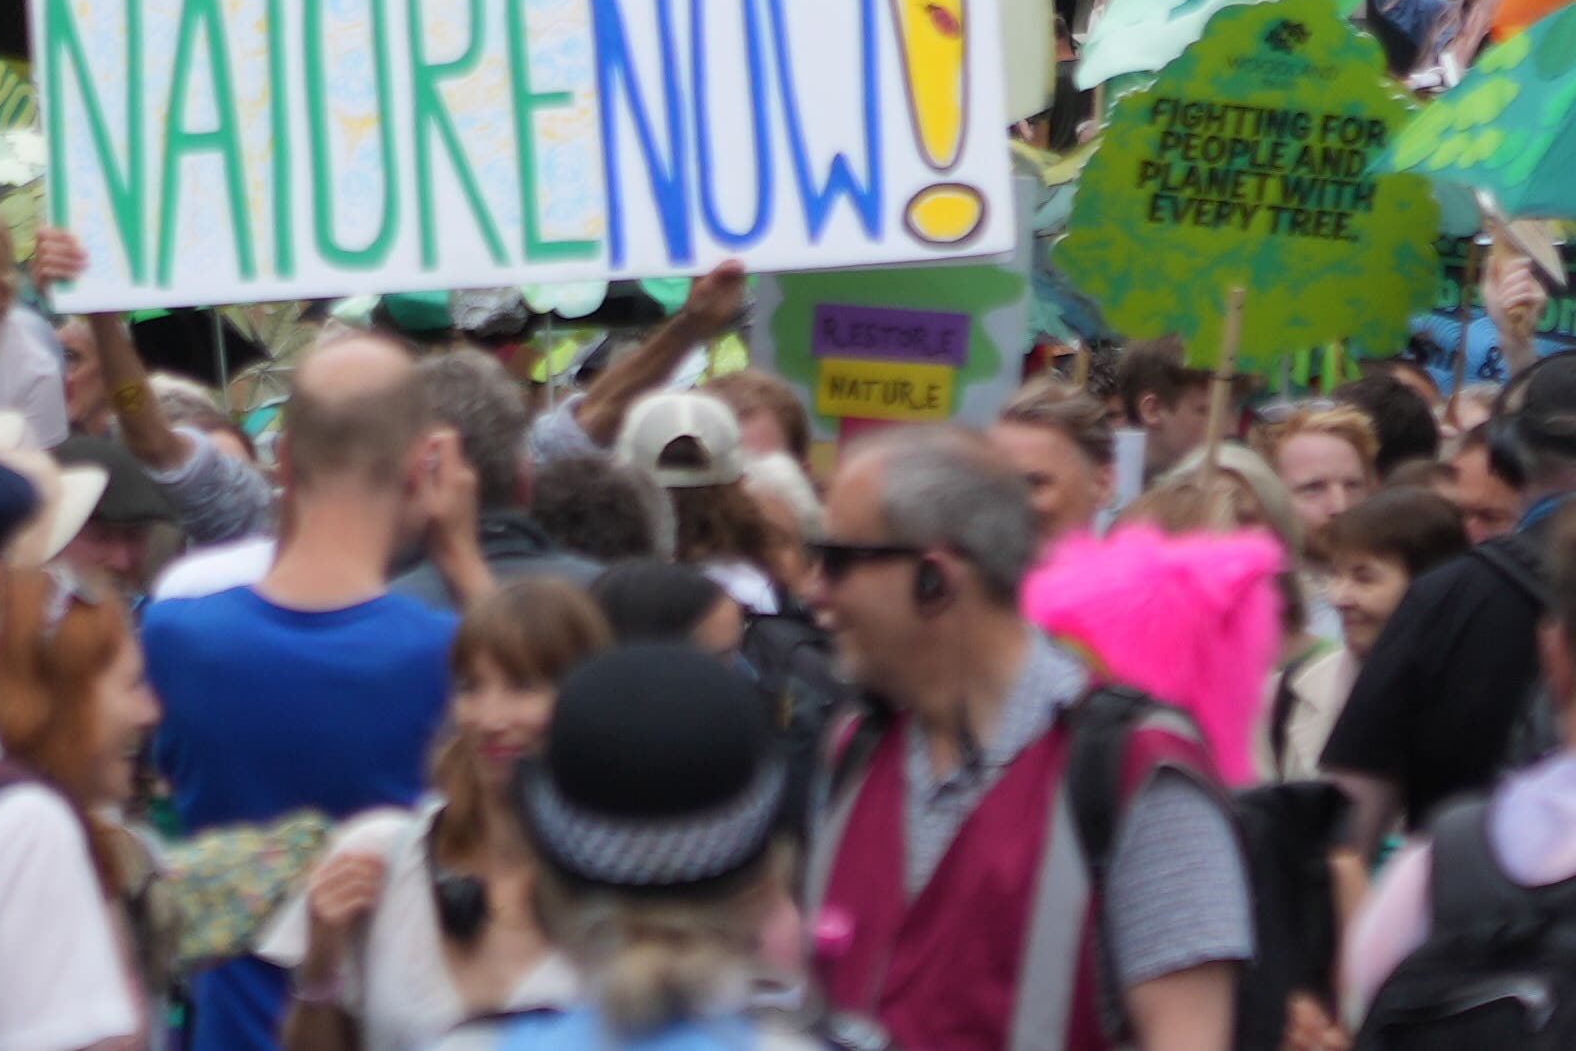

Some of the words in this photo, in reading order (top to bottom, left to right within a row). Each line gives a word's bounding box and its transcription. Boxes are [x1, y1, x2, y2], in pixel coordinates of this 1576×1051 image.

[1150, 98, 1312, 141] FIGHTING
[1321, 113, 1388, 149] FOR
[1159, 129, 1289, 170] PEOPLE
[1292, 144, 1368, 177] AND
[1136, 159, 1271, 201] PLANET
[1279, 173, 1378, 212] WITH
[1148, 193, 1258, 231] EVERY
[1269, 204, 1360, 243] TREE.
[823, 316, 957, 357] RESTORE
[828, 375, 941, 411] NATURE
